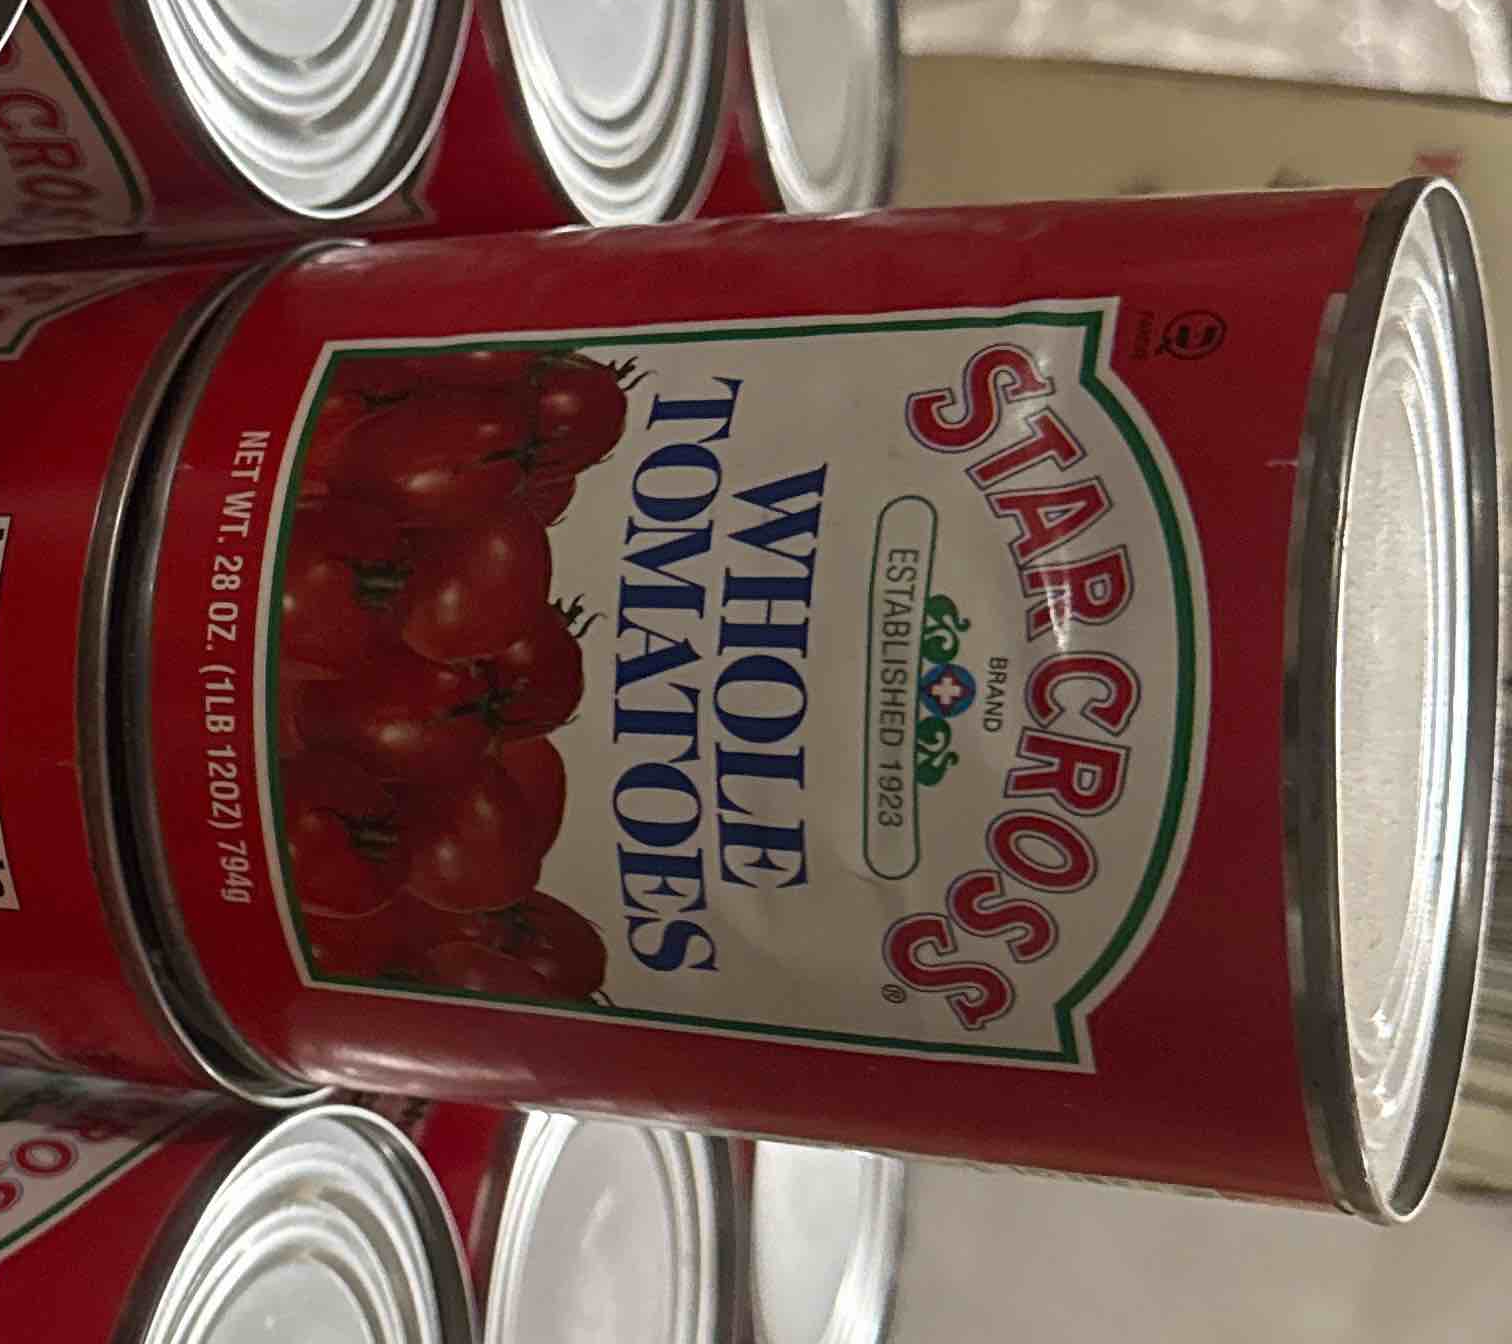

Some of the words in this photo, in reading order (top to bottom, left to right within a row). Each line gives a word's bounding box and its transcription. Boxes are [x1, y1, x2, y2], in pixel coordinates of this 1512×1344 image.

[230, 429, 272, 482] NET
[215, 491, 258, 543] WT.
[904, 343, 1135, 643] STAR
[209, 555, 245, 592] 28
[205, 601, 239, 651] OZ.
[877, 547, 916, 748] ESTABLISHED
[200, 664, 238, 734] (1LB
[612, 377, 743, 973] TOMATOES
[713, 463, 829, 891] WHOLE
[981, 657, 1008, 733] BRAND
[877, 760, 905, 829] 1923
[213, 839, 255, 905] 794g
[881, 651, 1141, 1032] CROSS
